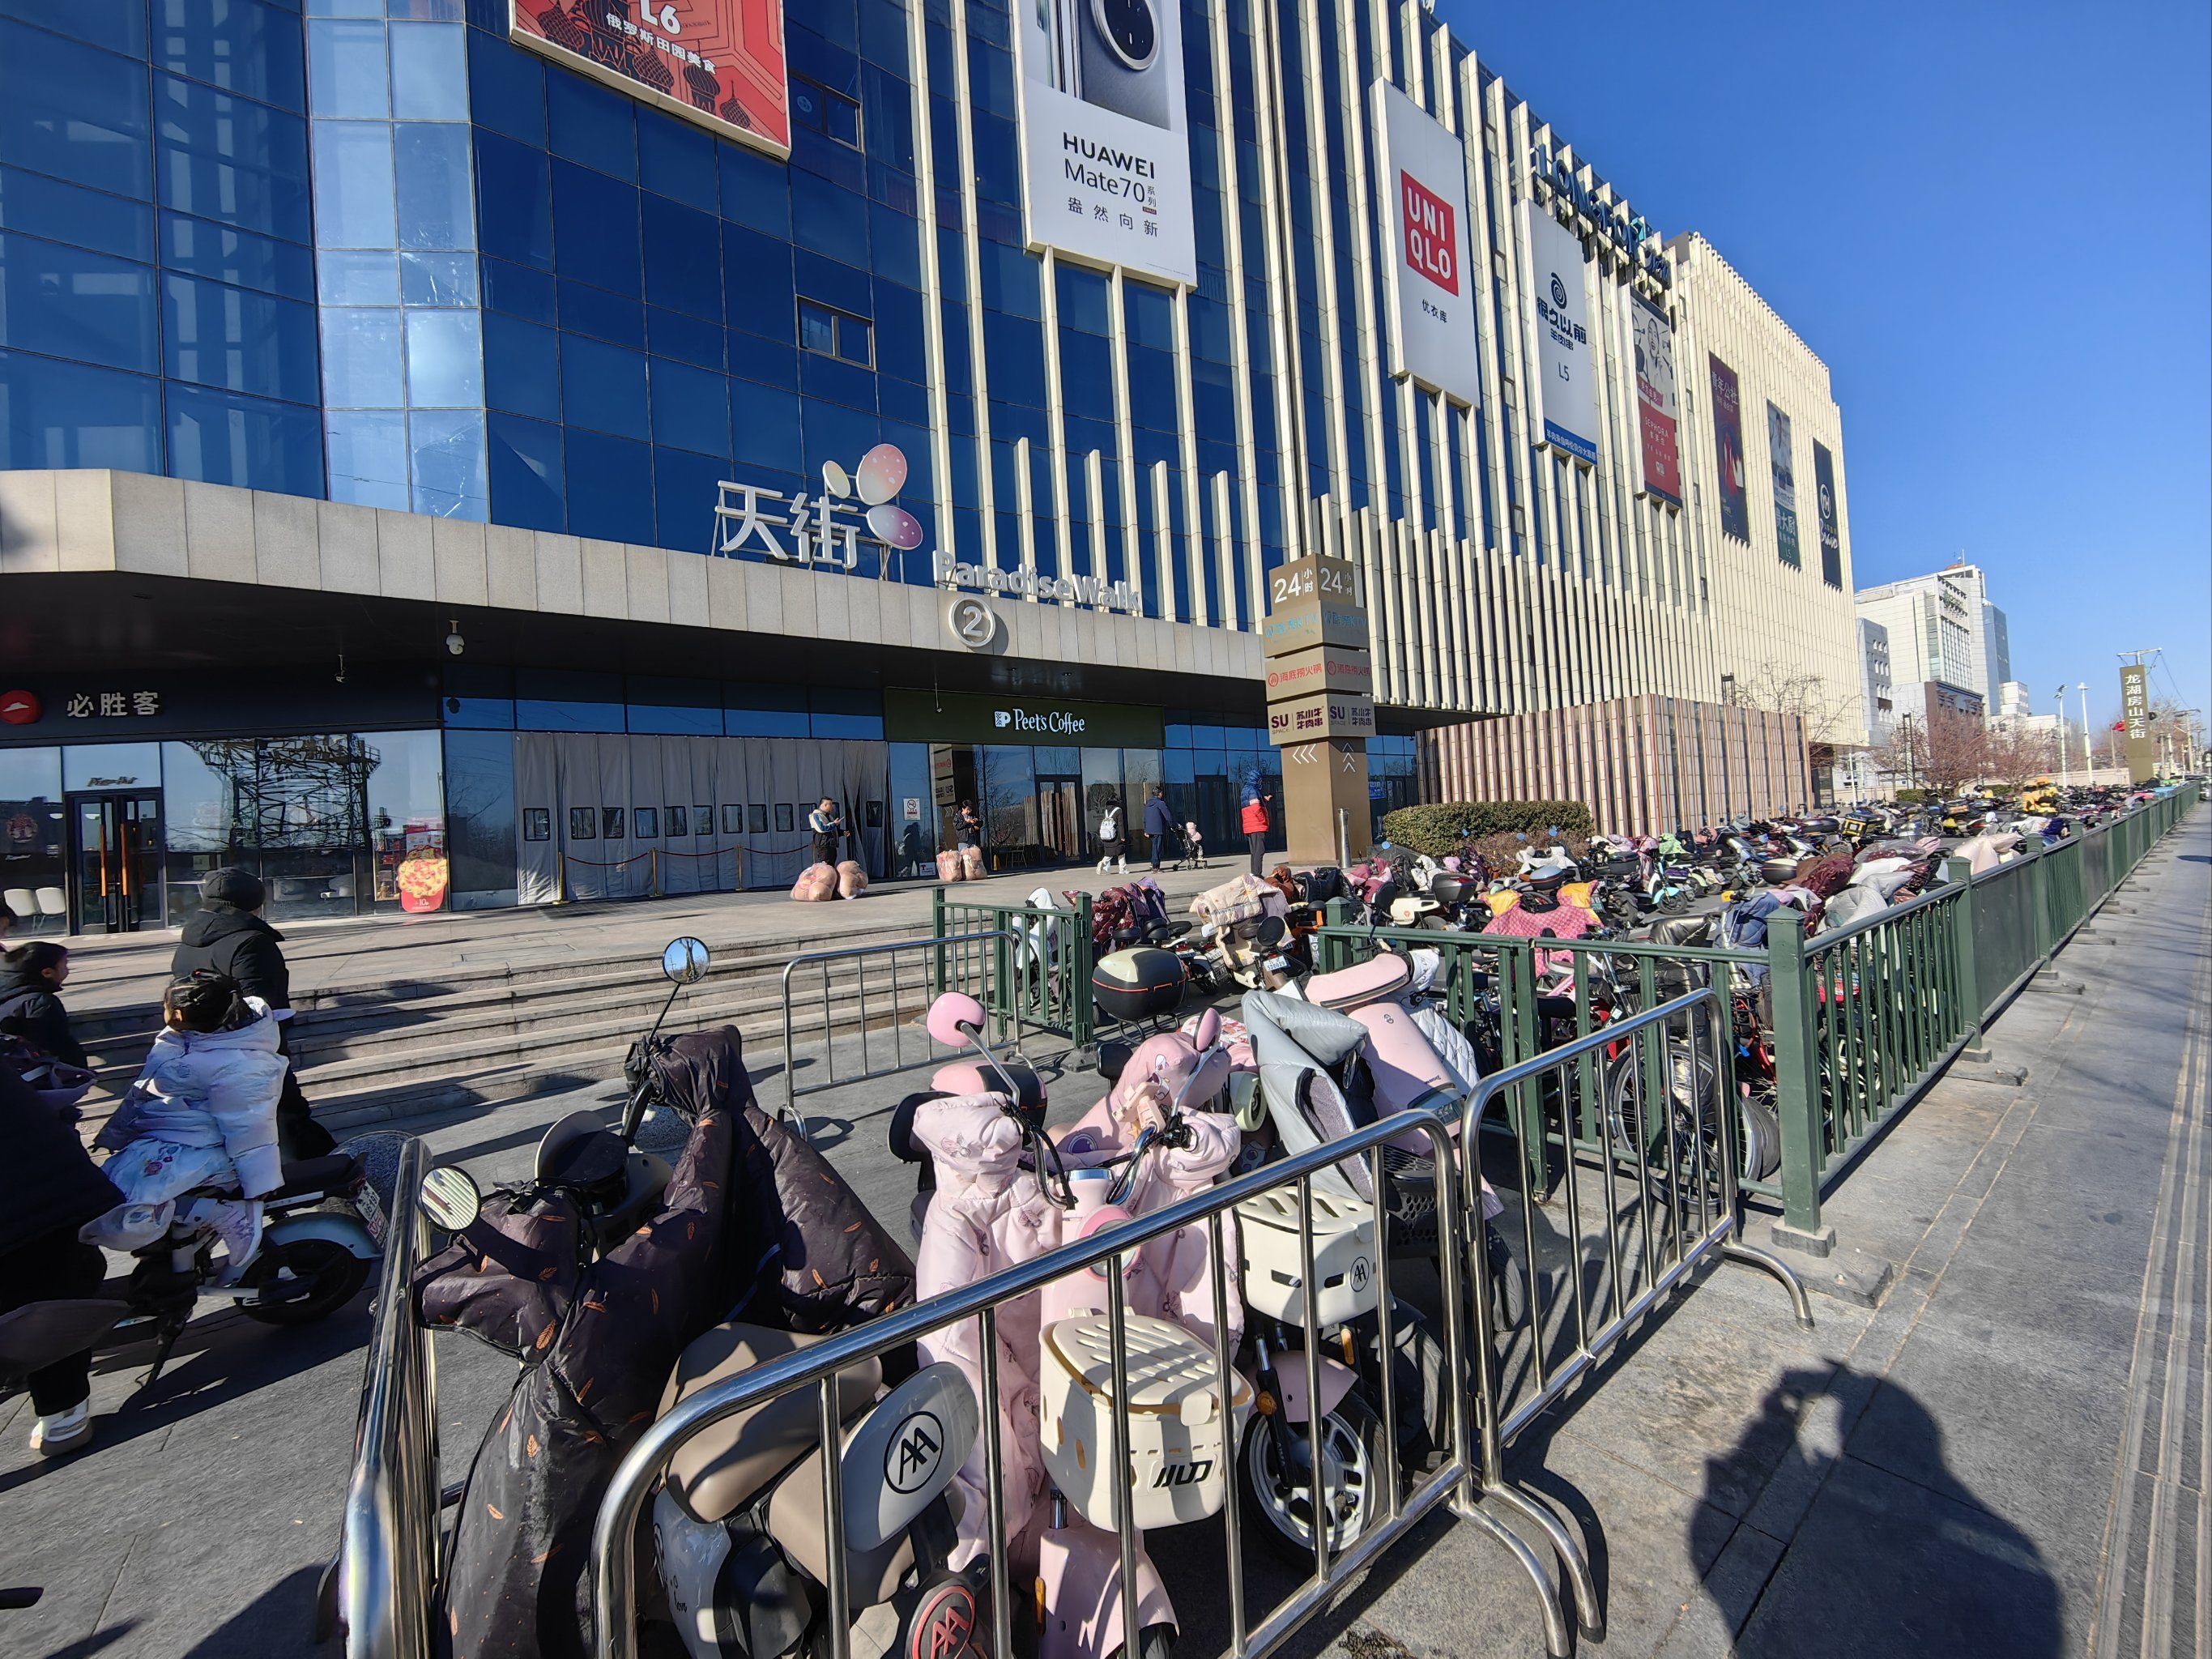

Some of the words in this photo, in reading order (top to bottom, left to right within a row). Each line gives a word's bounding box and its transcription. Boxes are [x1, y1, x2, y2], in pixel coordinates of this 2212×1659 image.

[640, 0, 682, 35] L6
[606, 12, 717, 75] 俄罗斯田园美食
[1063, 132, 1155, 179] HUAWEI
[1064, 159, 1145, 203] Mate70
[1147, 186, 1157, 207] 系列
[1068, 197, 1158, 237] 盎然向新
[1408, 186, 1446, 243] UNI
[1410, 228, 1451, 279] QLO
[1422, 298, 1447, 323] 优衣库
[1537, 296, 1587, 345] 很久以前
[1550, 328, 1574, 351] 羊肉串
[1558, 361, 1570, 382] L5
[715, 480, 861, 569] 天街
[933, 549, 1072, 601] Paradise
[1072, 574, 1142, 612] Walk
[1274, 572, 1302, 603] 24
[1303, 568, 1314, 594] 小时
[1320, 567, 1343, 594] 24
[962, 606, 983, 638] 2
[1281, 663, 1323, 683] 海底捞火锅
[1337, 663, 1370, 677] 海底捞火锅
[66, 691, 160, 718] 必胜客
[1296, 708, 1323, 721] 苏小牛
[1329, 706, 1345, 719] SU
[1351, 707, 1371, 717] 苏小牛
[2125, 674, 2146, 740] 龙湖房山天街
[1012, 708, 1047, 732] Peet's
[1049, 711, 1085, 736] Coffee
[1271, 714, 1289, 729] SU
[1297, 717, 1323, 730] 牛肉串
[1352, 717, 1372, 727] 牛肉串
